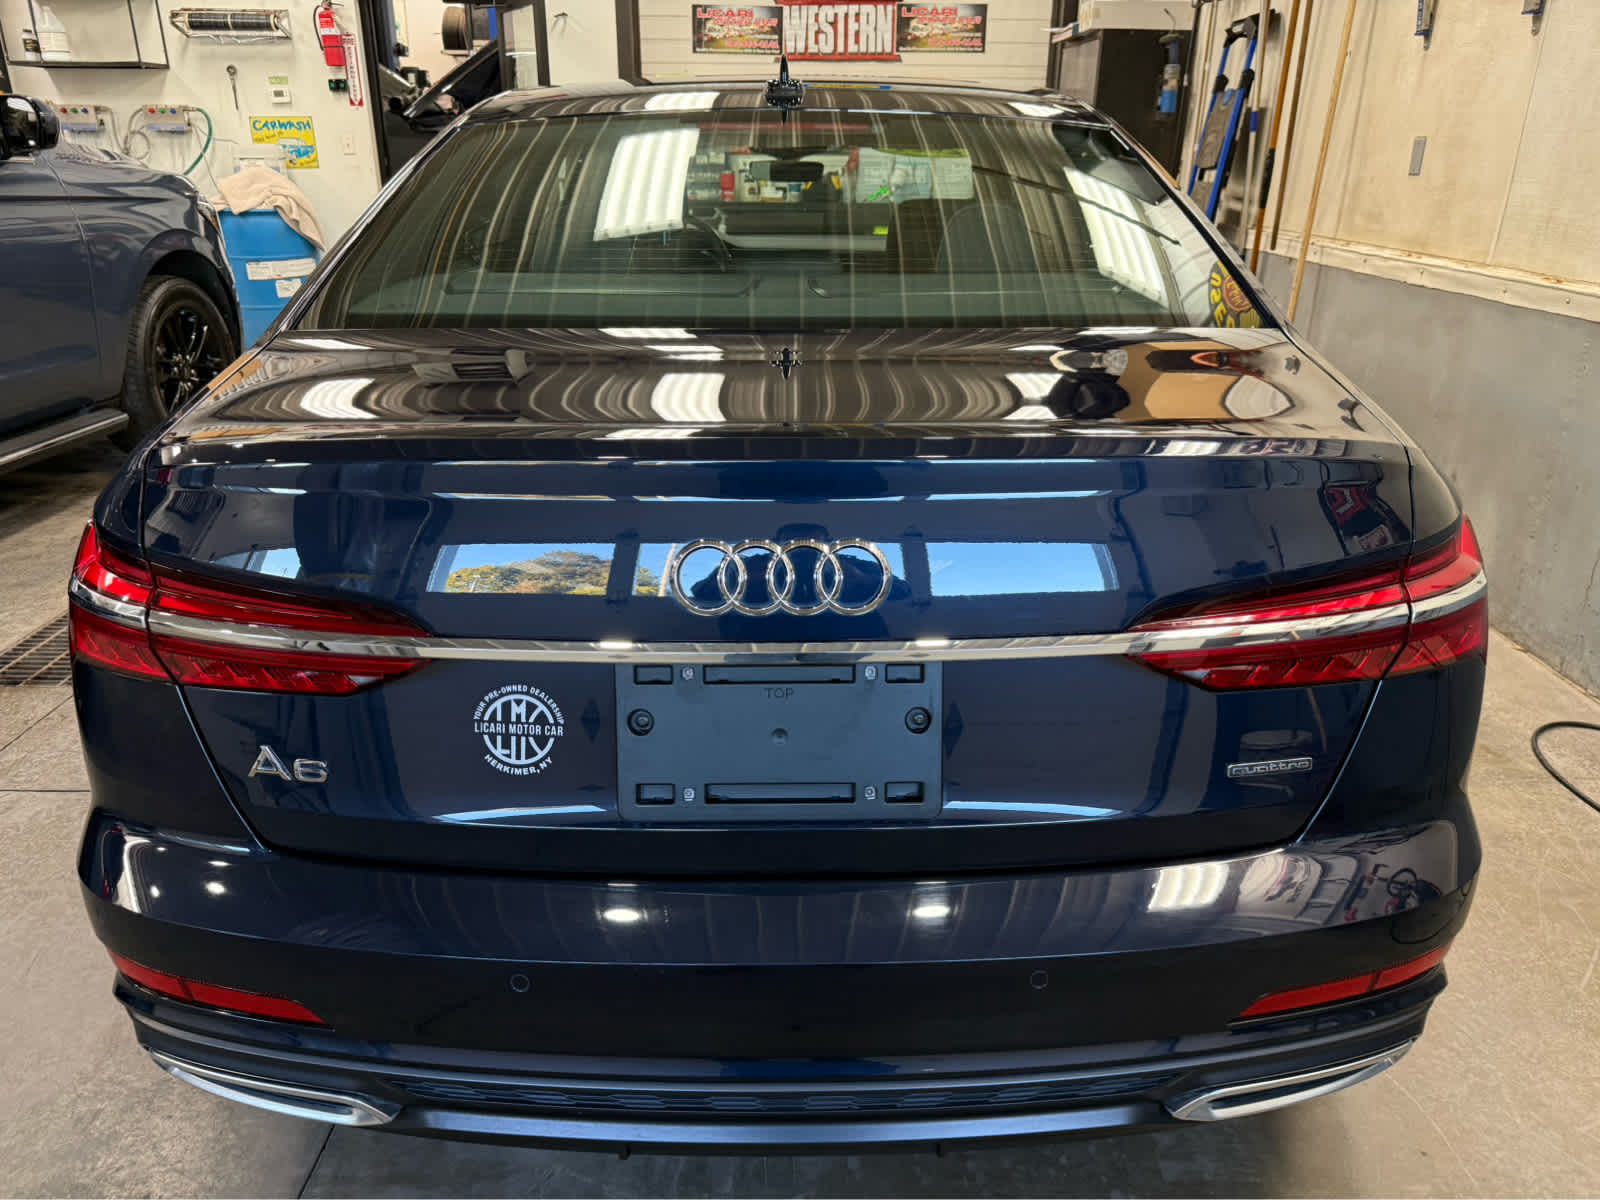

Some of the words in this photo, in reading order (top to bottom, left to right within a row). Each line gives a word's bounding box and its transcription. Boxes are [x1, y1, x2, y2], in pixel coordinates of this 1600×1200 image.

[783, 4, 893, 54] WESTERN
[763, 687, 795, 700] TOP
[473, 701, 487, 720] YOUR
[484, 684, 528, 702] PRE-OWNED
[530, 686, 565, 724] DEALERSHIP
[474, 721, 506, 734] LICARI
[509, 723, 541, 736] MOTOR
[544, 725, 564, 737] CAR
[247, 744, 328, 783] A6
[539, 756, 553, 770] NY
[1231, 760, 1311, 776] quattro
